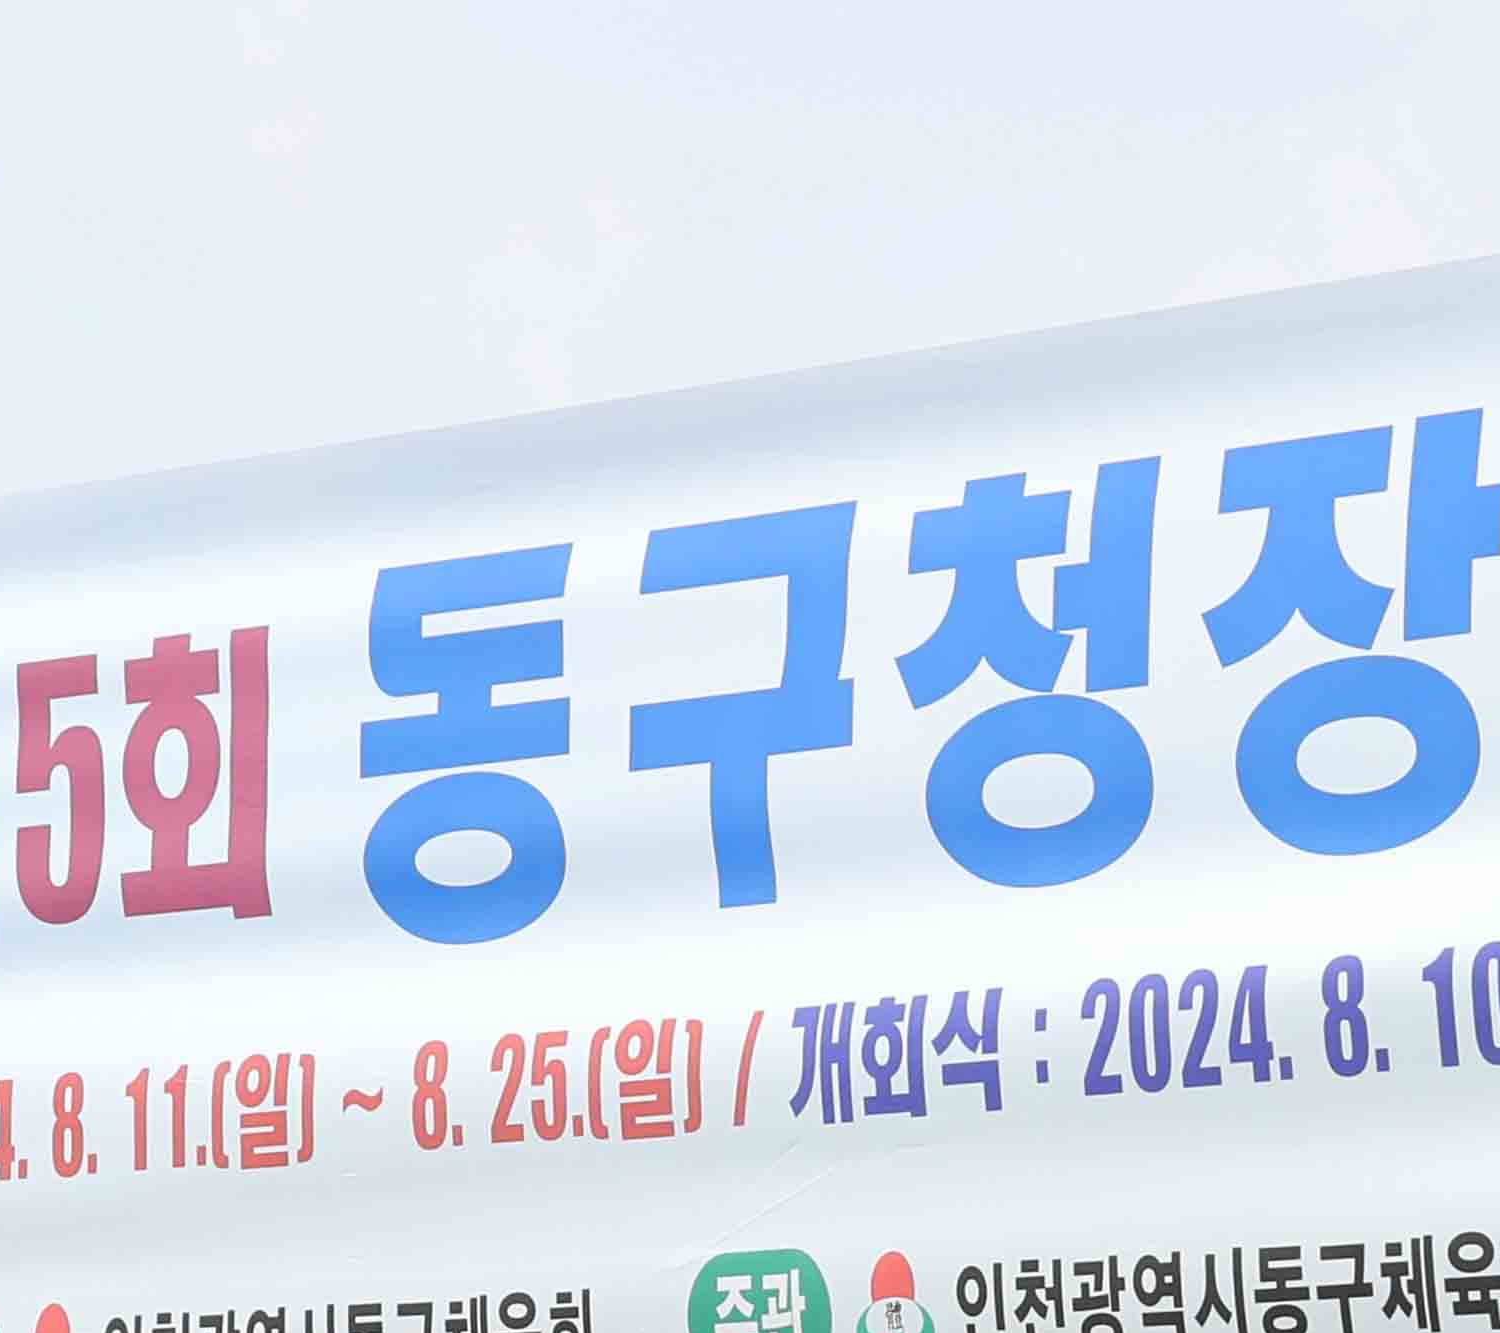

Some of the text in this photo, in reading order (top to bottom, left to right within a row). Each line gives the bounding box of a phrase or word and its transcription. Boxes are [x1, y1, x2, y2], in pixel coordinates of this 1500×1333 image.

[52, 1071, 98, 1178] 8.
[127, 1054, 315, 1170] 11.(일)
[413, 1039, 464, 1150] 8.
[492, 1018, 703, 1144] 25.(일)
[792, 989, 1001, 1122] 개회식
[1081, 965, 1293, 1095] 2024.
[1323, 955, 1388, 1077] 8.
